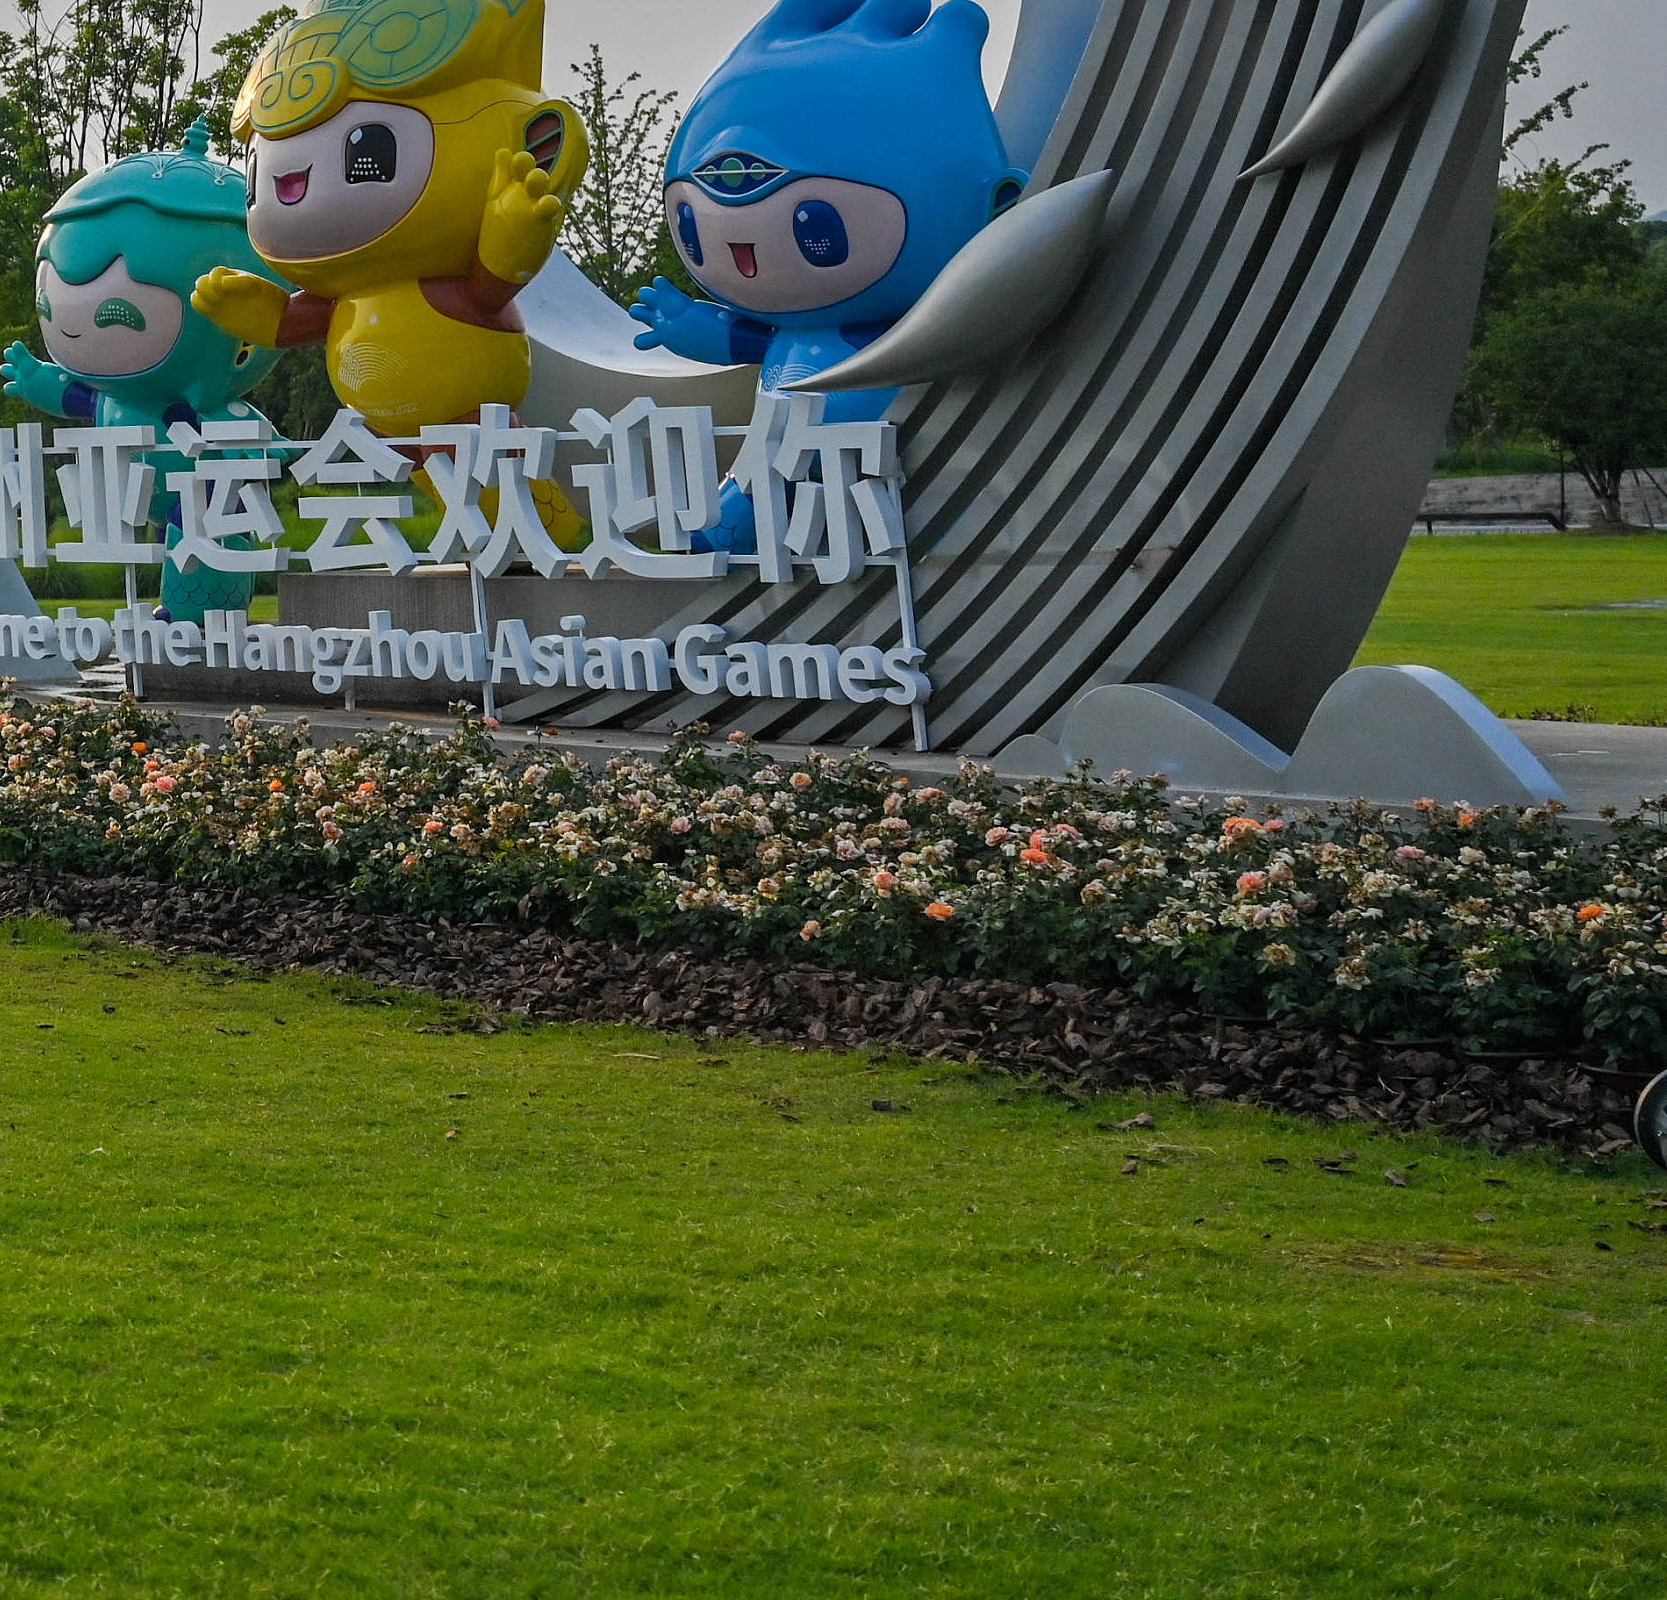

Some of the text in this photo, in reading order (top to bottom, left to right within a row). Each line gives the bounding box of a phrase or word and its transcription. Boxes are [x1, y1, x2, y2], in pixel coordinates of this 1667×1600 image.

[55, 607, 113, 663] to
[113, 603, 202, 667] the
[204, 610, 489, 694] Hangzhou
[491, 615, 671, 691] Asian
[674, 623, 933, 706] Games
